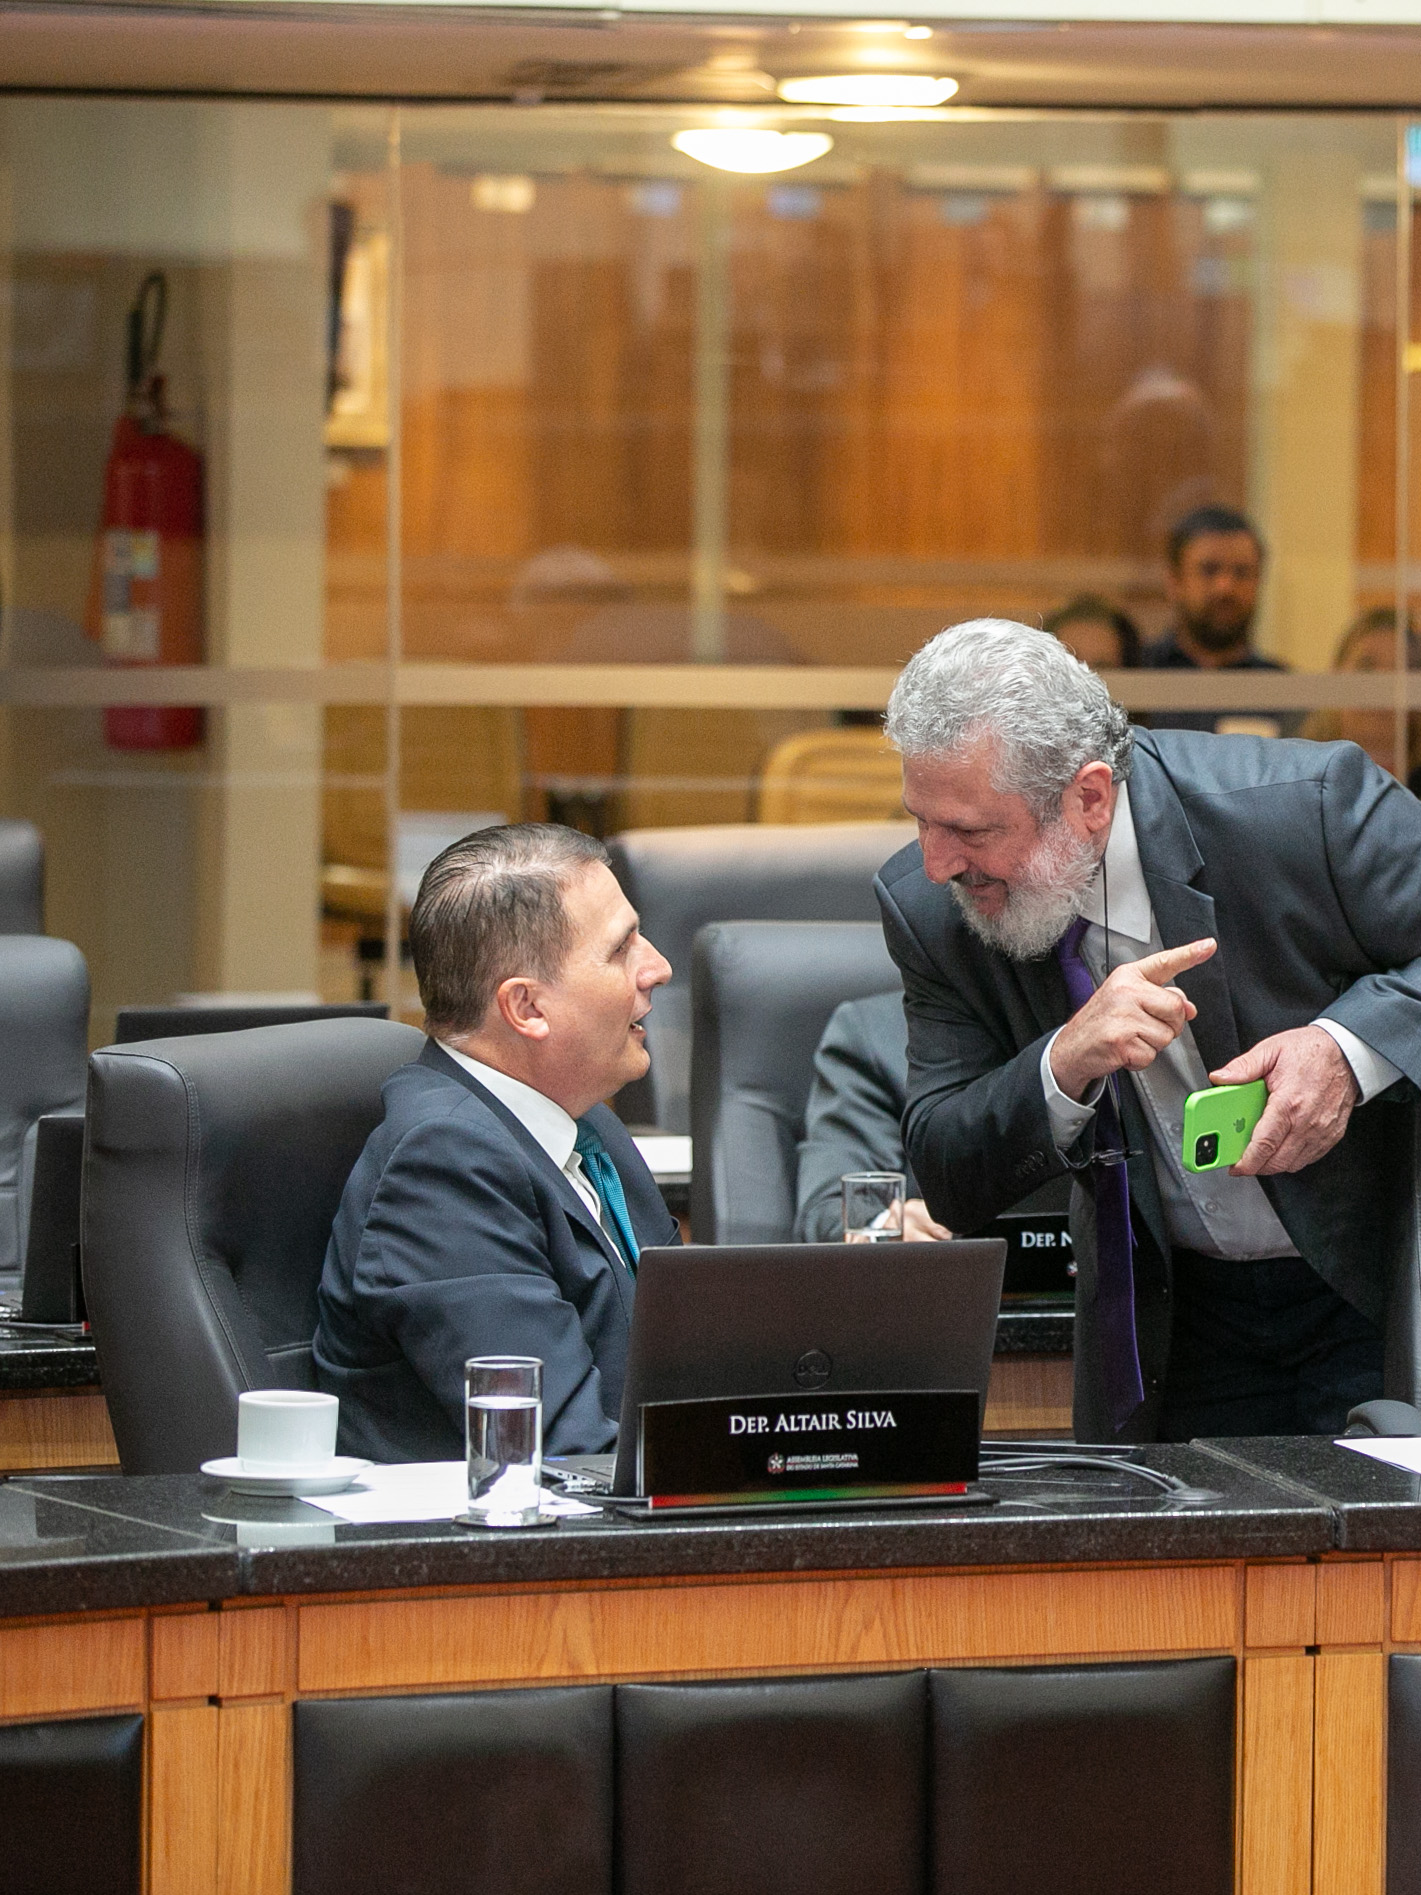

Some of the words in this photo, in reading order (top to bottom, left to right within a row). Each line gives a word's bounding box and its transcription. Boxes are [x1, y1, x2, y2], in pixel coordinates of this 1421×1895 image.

[1020, 1231, 1056, 1248] DEP.
[729, 1415, 770, 1435] DEP.
[774, 1413, 842, 1433] ALTAIR
[846, 1410, 897, 1429] SILVA
